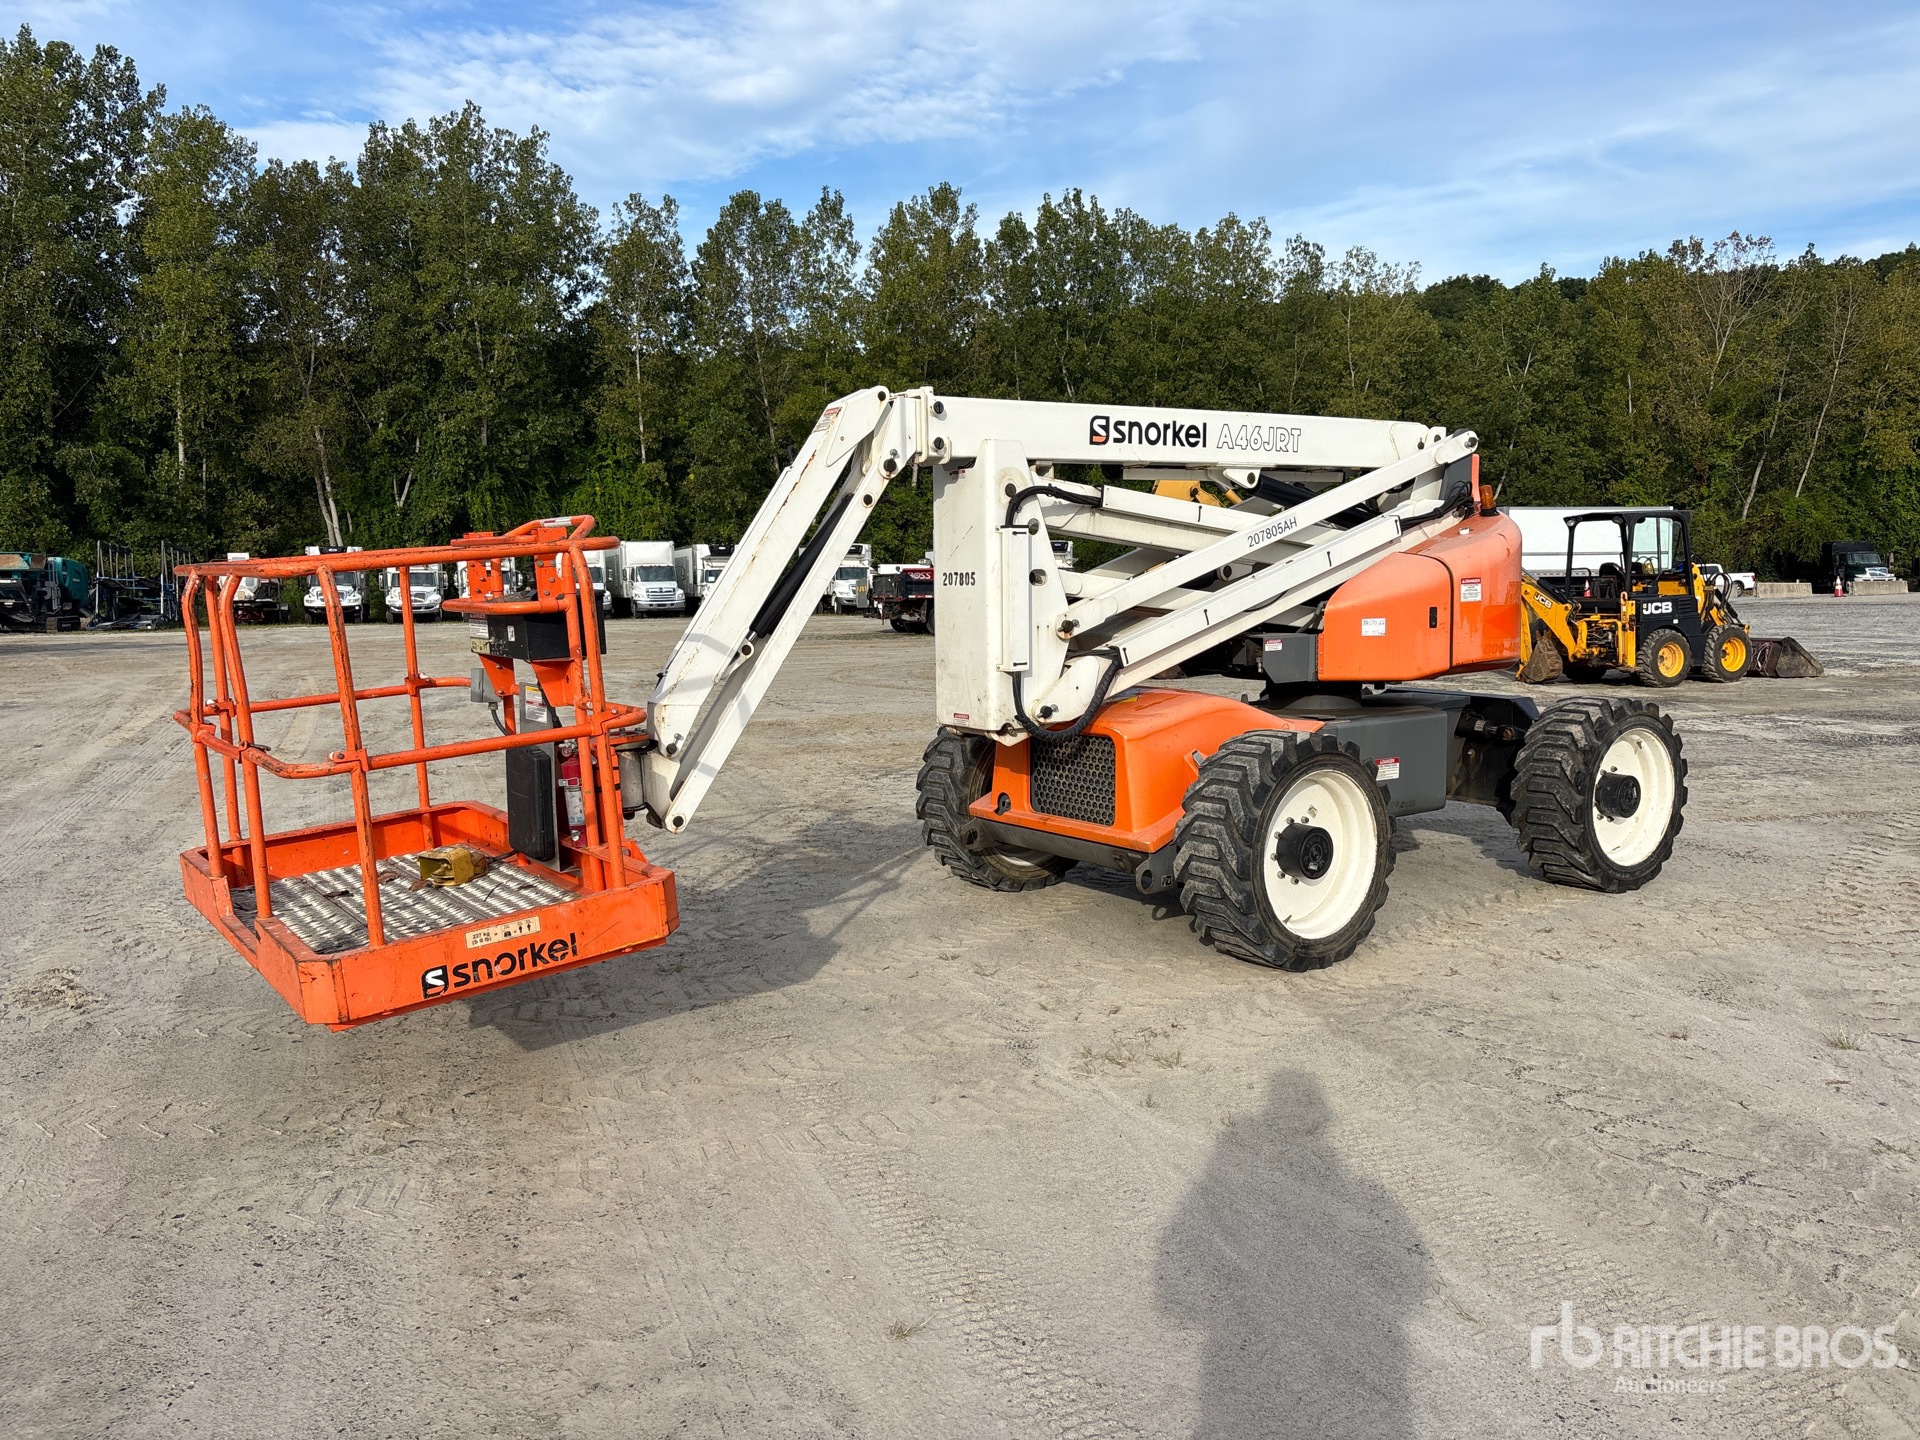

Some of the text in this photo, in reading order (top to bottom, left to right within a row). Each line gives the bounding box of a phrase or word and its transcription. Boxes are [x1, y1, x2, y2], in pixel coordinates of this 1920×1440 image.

[1113, 420, 1207, 448] snorkel
[1216, 423, 1302, 453] A46JRT
[1248, 516, 1298, 548] 207805AH
[942, 571, 976, 587] 207805
[1533, 591, 1553, 610] JCB
[1642, 601, 1673, 615] JCB
[452, 932, 578, 989] snorkel
